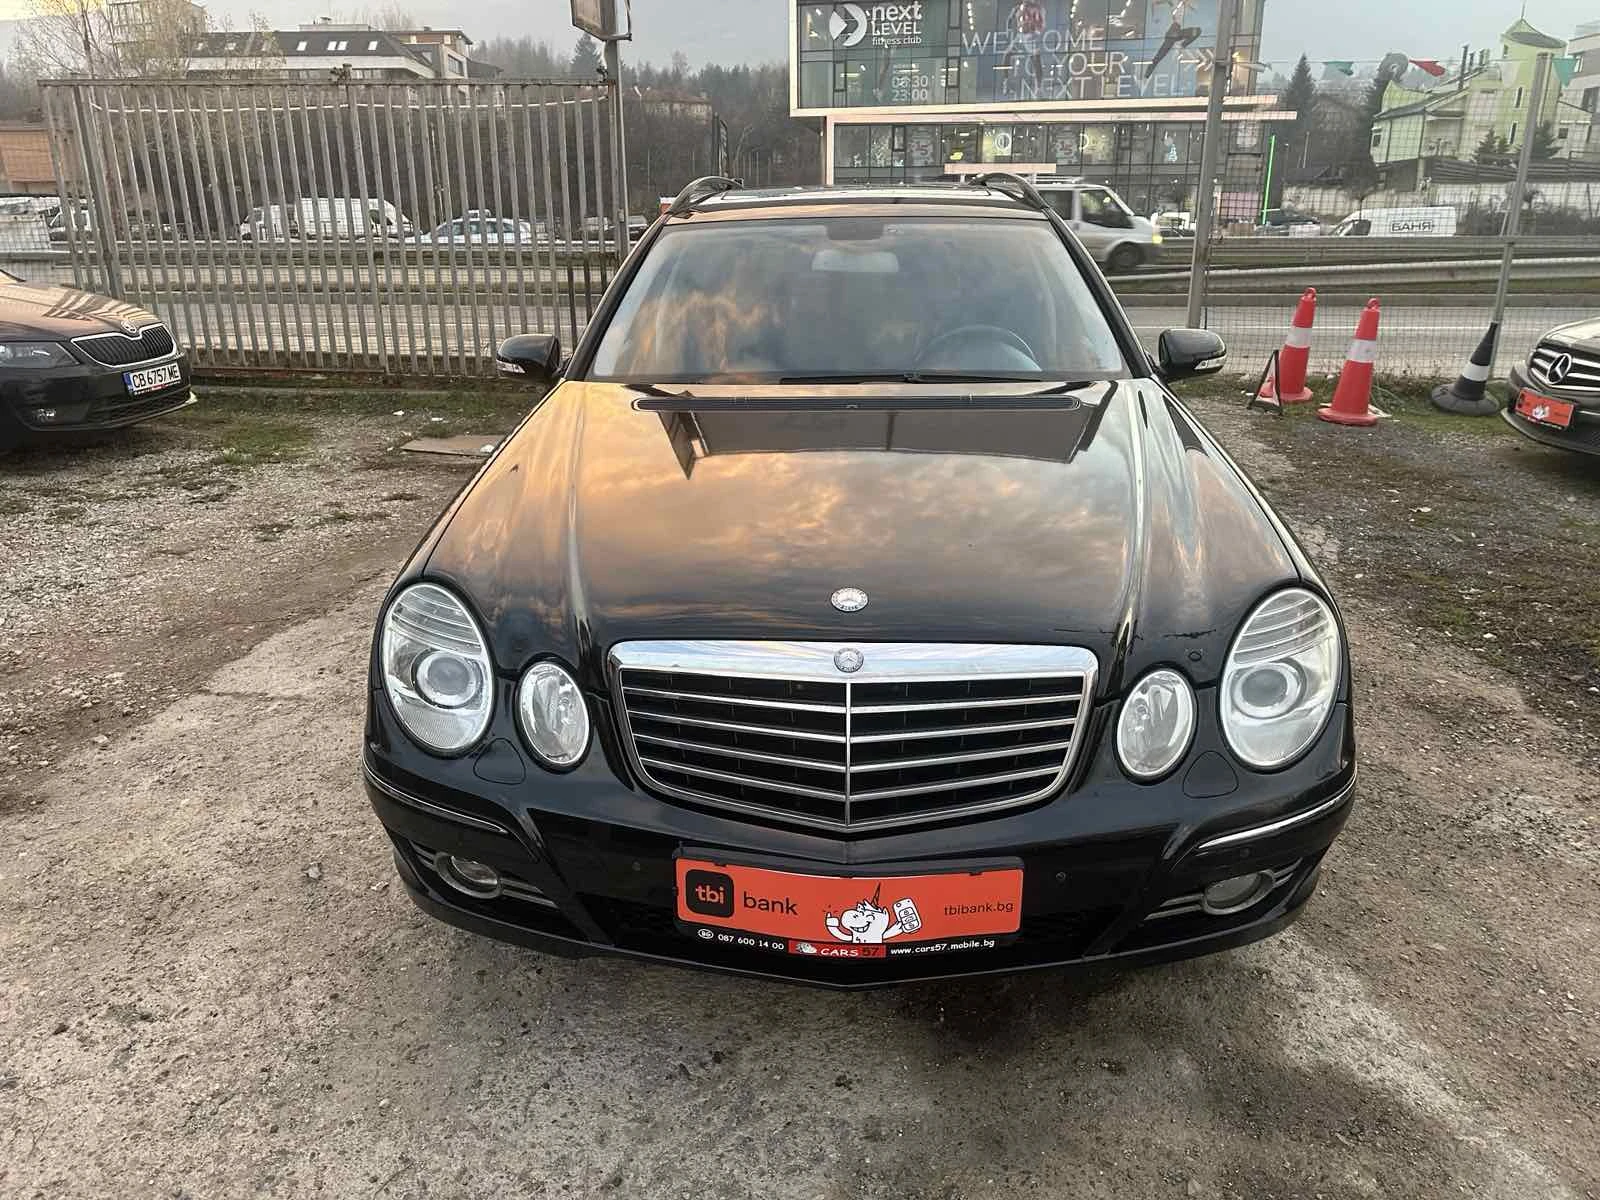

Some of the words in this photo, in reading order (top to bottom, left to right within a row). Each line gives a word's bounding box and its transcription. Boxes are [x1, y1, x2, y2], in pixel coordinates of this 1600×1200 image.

[872, 1, 922, 21] next
[871, 21, 922, 36] LEVEL
[872, 36, 900, 46] fitness
[903, 36, 922, 45] club
[1051, 51, 1127, 76] YOUR
[1020, 76, 1092, 100] NEXT
[1102, 73, 1185, 98] LEVEL
[1391, 221, 1431, 232] БАНЯ
[146, 367, 168, 385] 6757
[695, 884, 726, 905] tbi
[743, 891, 798, 916] bank
[944, 901, 1014, 916] tbibank.bg
[717, 933, 735, 943] 087
[737, 937, 756, 946] 600
[758, 939, 769, 948] 14
[771, 942, 785, 951] 00
[890, 938, 996, 956] www.cars57.mobile.bg
[820, 947, 859, 957] CARS
[862, 946, 880, 957] 57
